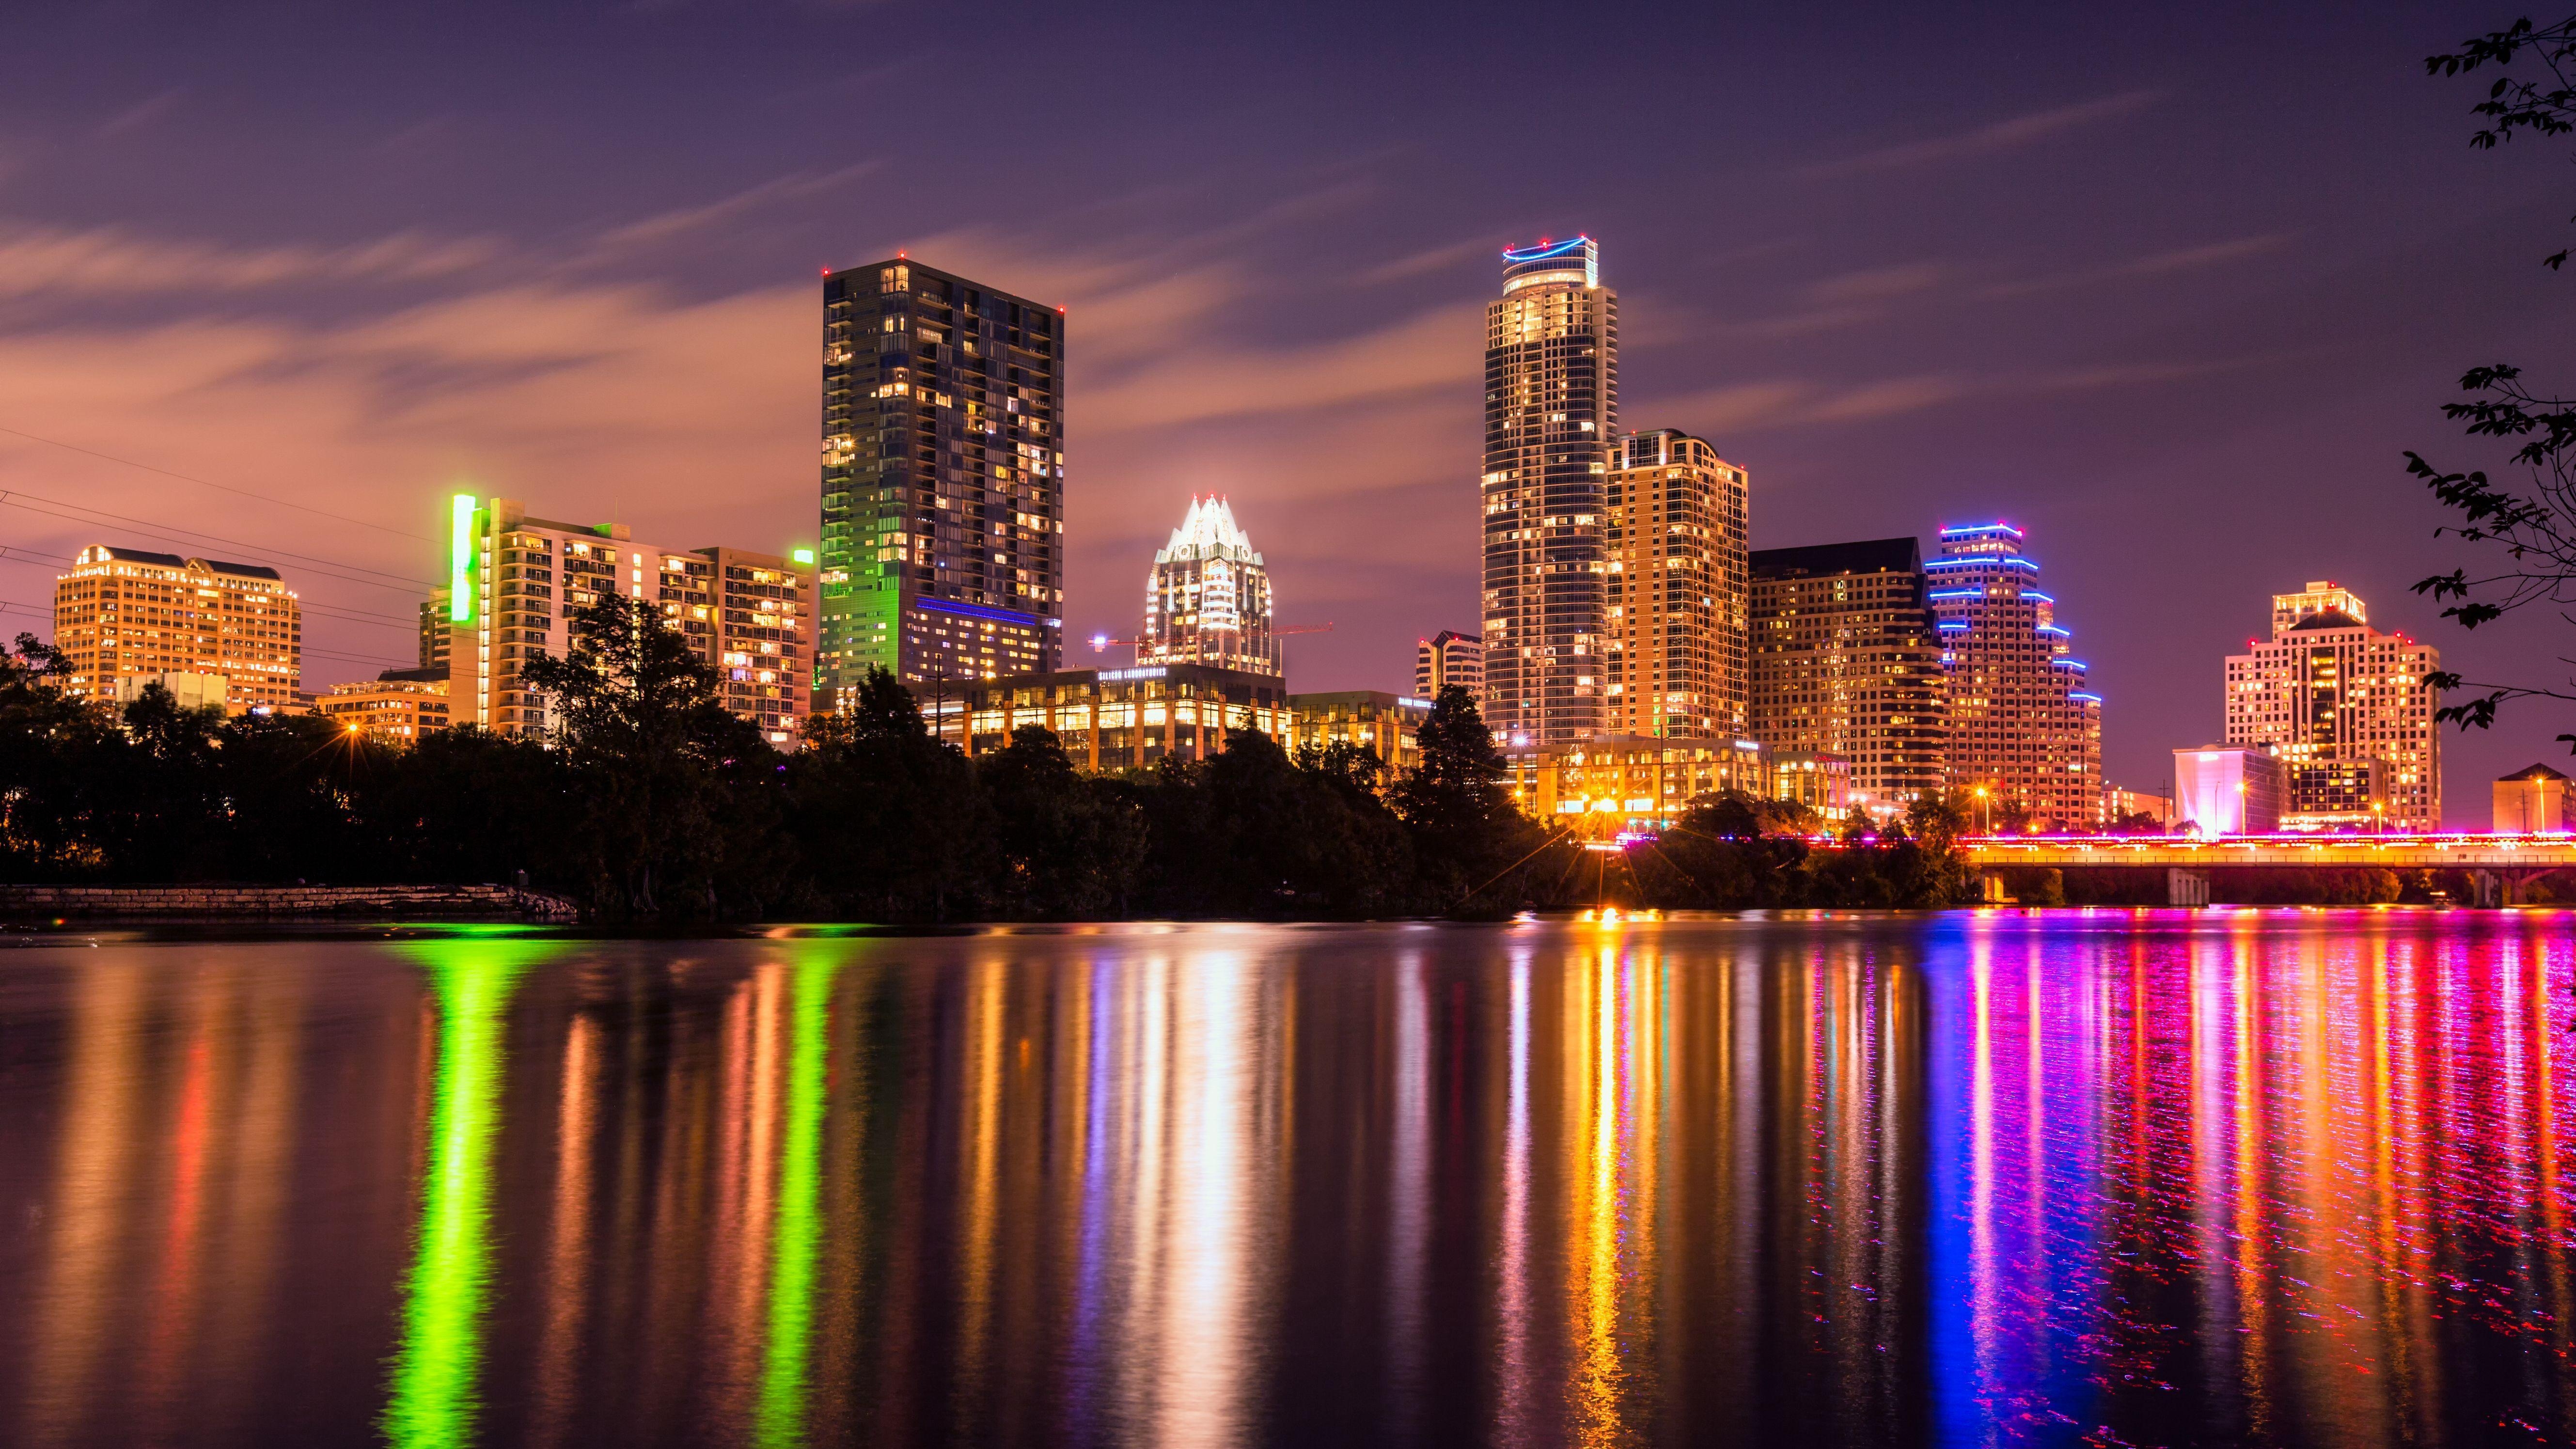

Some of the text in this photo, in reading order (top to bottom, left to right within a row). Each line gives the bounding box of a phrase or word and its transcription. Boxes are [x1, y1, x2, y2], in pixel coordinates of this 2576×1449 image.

[1053, 618, 1061, 628] W
[1099, 668, 1166, 680] SILICON LABORATORIES
